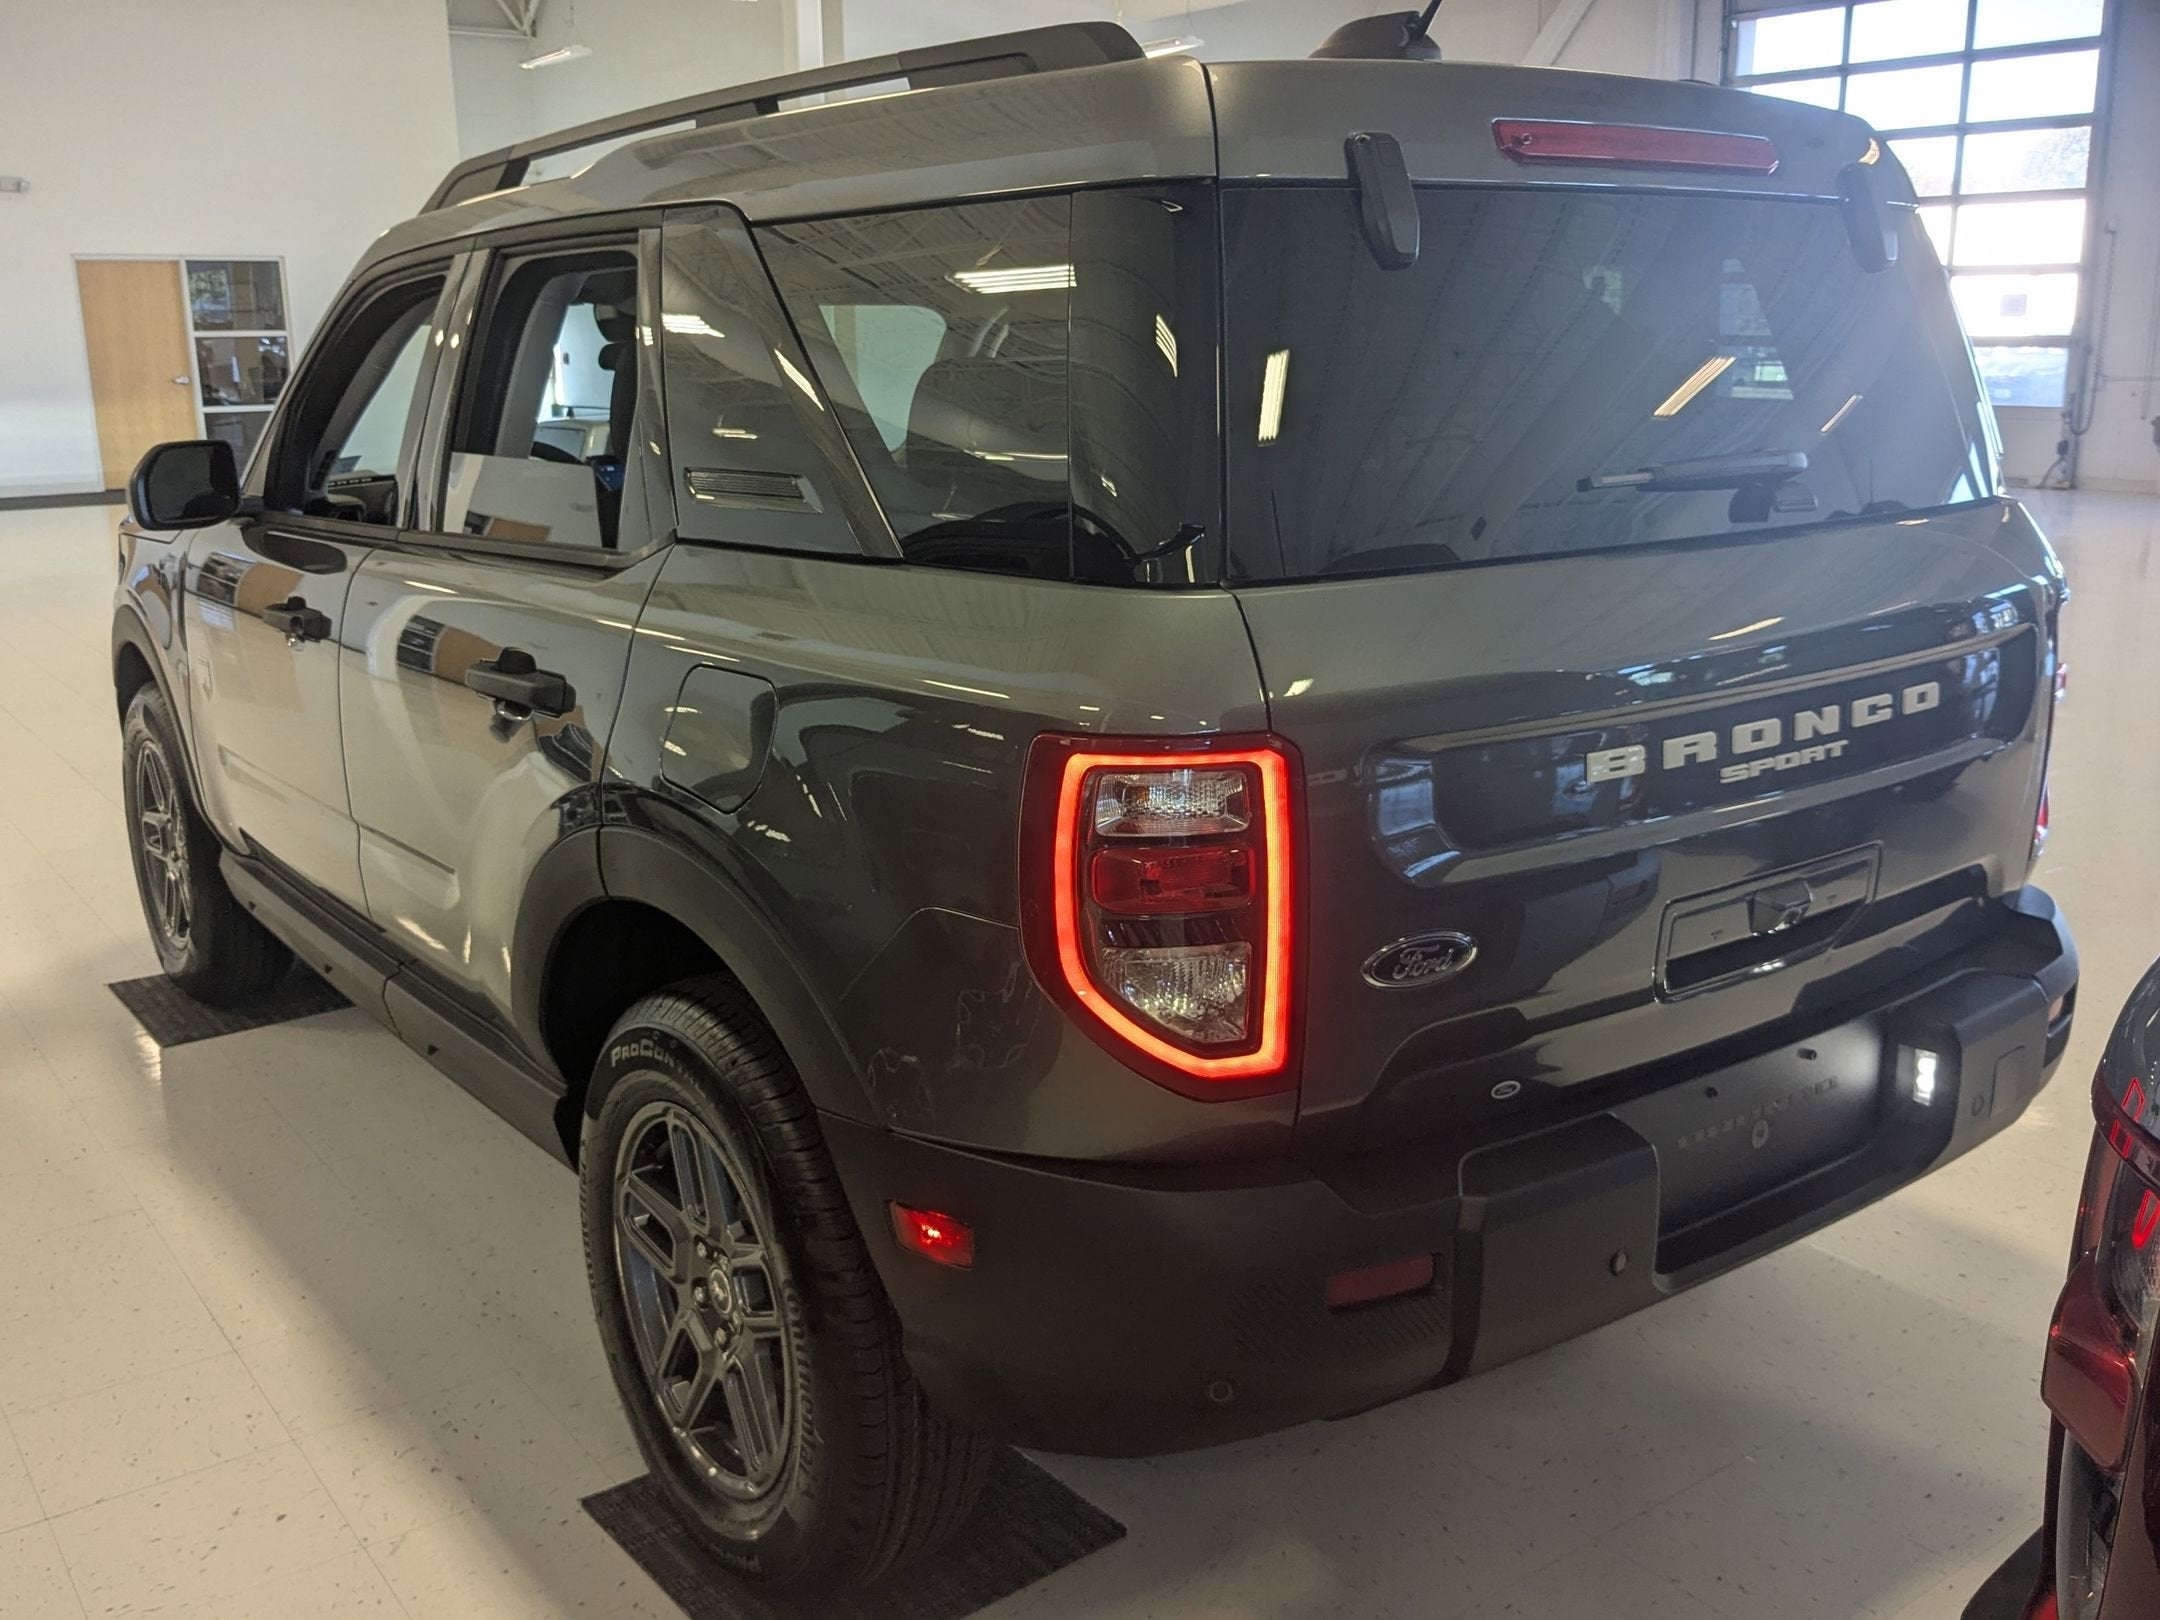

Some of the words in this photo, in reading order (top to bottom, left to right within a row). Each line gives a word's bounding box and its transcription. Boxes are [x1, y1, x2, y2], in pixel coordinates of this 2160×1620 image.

[1586, 681, 1940, 784] BRONCO
[1719, 739, 1849, 785] SPORT
[1392, 944, 1455, 980] Ford
